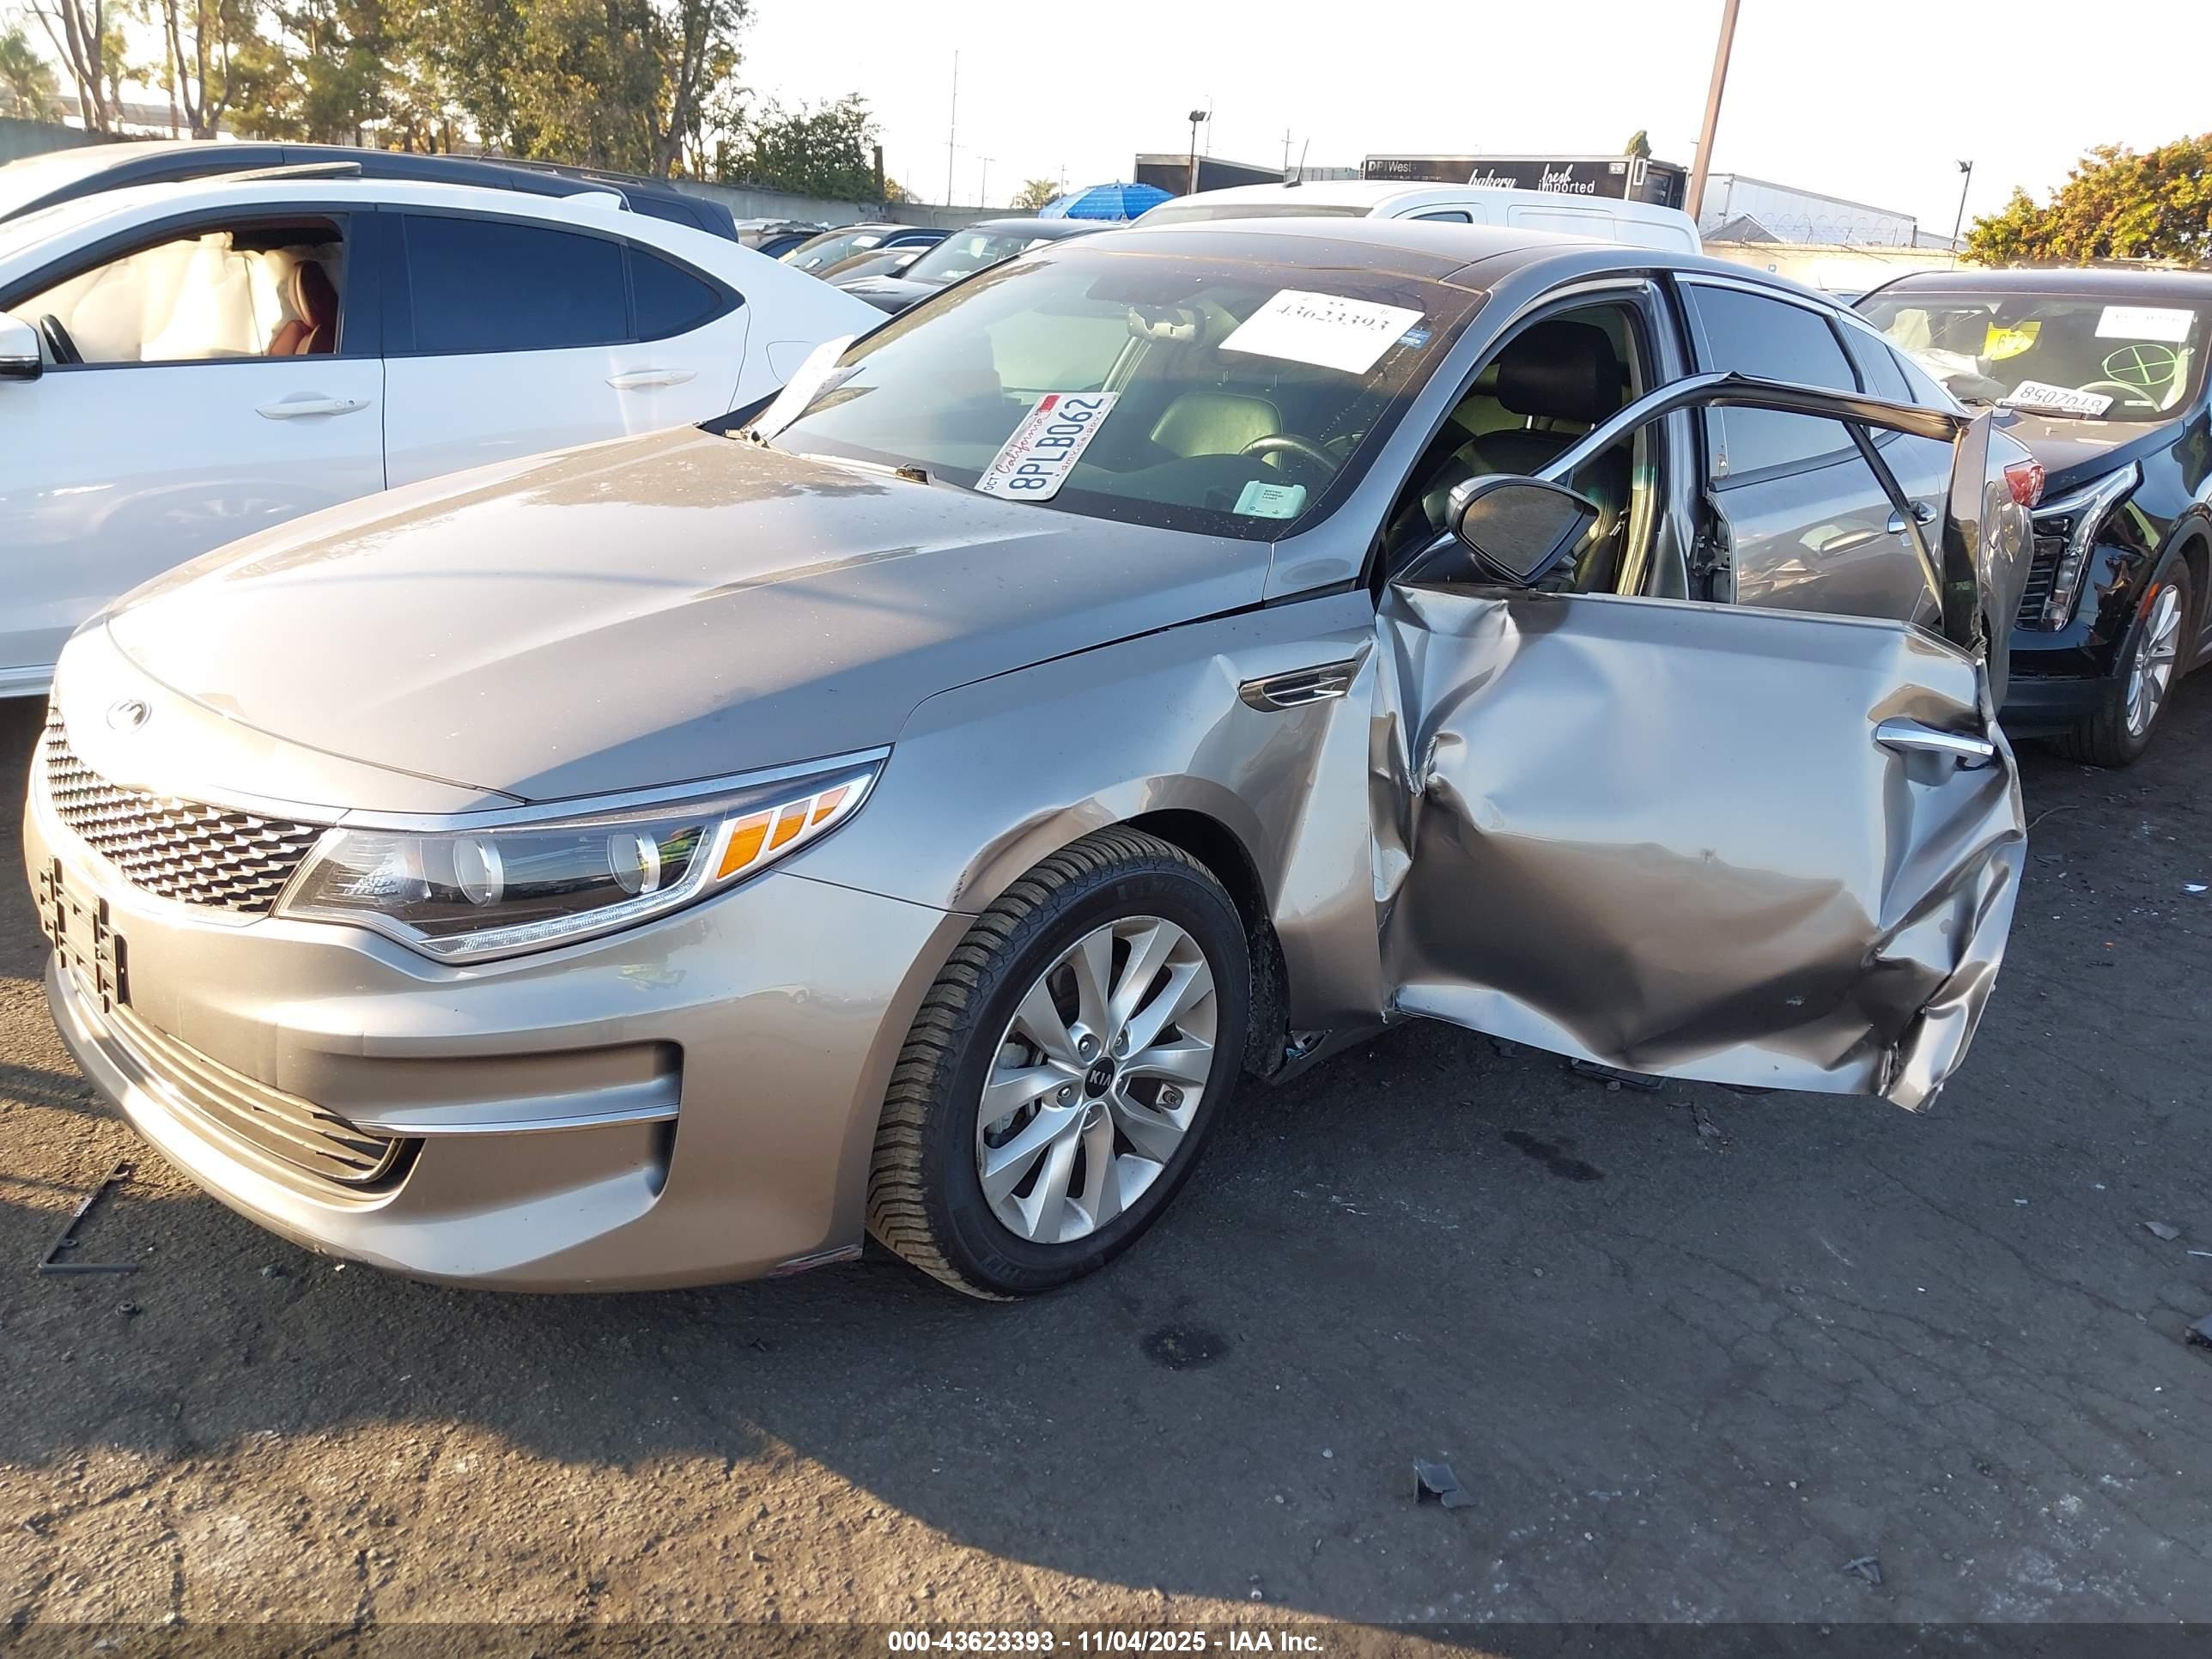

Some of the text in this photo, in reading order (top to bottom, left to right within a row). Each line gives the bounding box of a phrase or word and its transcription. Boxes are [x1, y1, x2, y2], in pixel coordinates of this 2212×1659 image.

[1468, 168, 1517, 189] bakery
[1542, 163, 1573, 184] fresh
[1538, 179, 1595, 193] imported
[995, 417, 1043, 474] California
[1009, 398, 1104, 490] 8PLB062
[983, 477, 1000, 490] OCT
[1090, 1069, 1111, 1086] KIA
